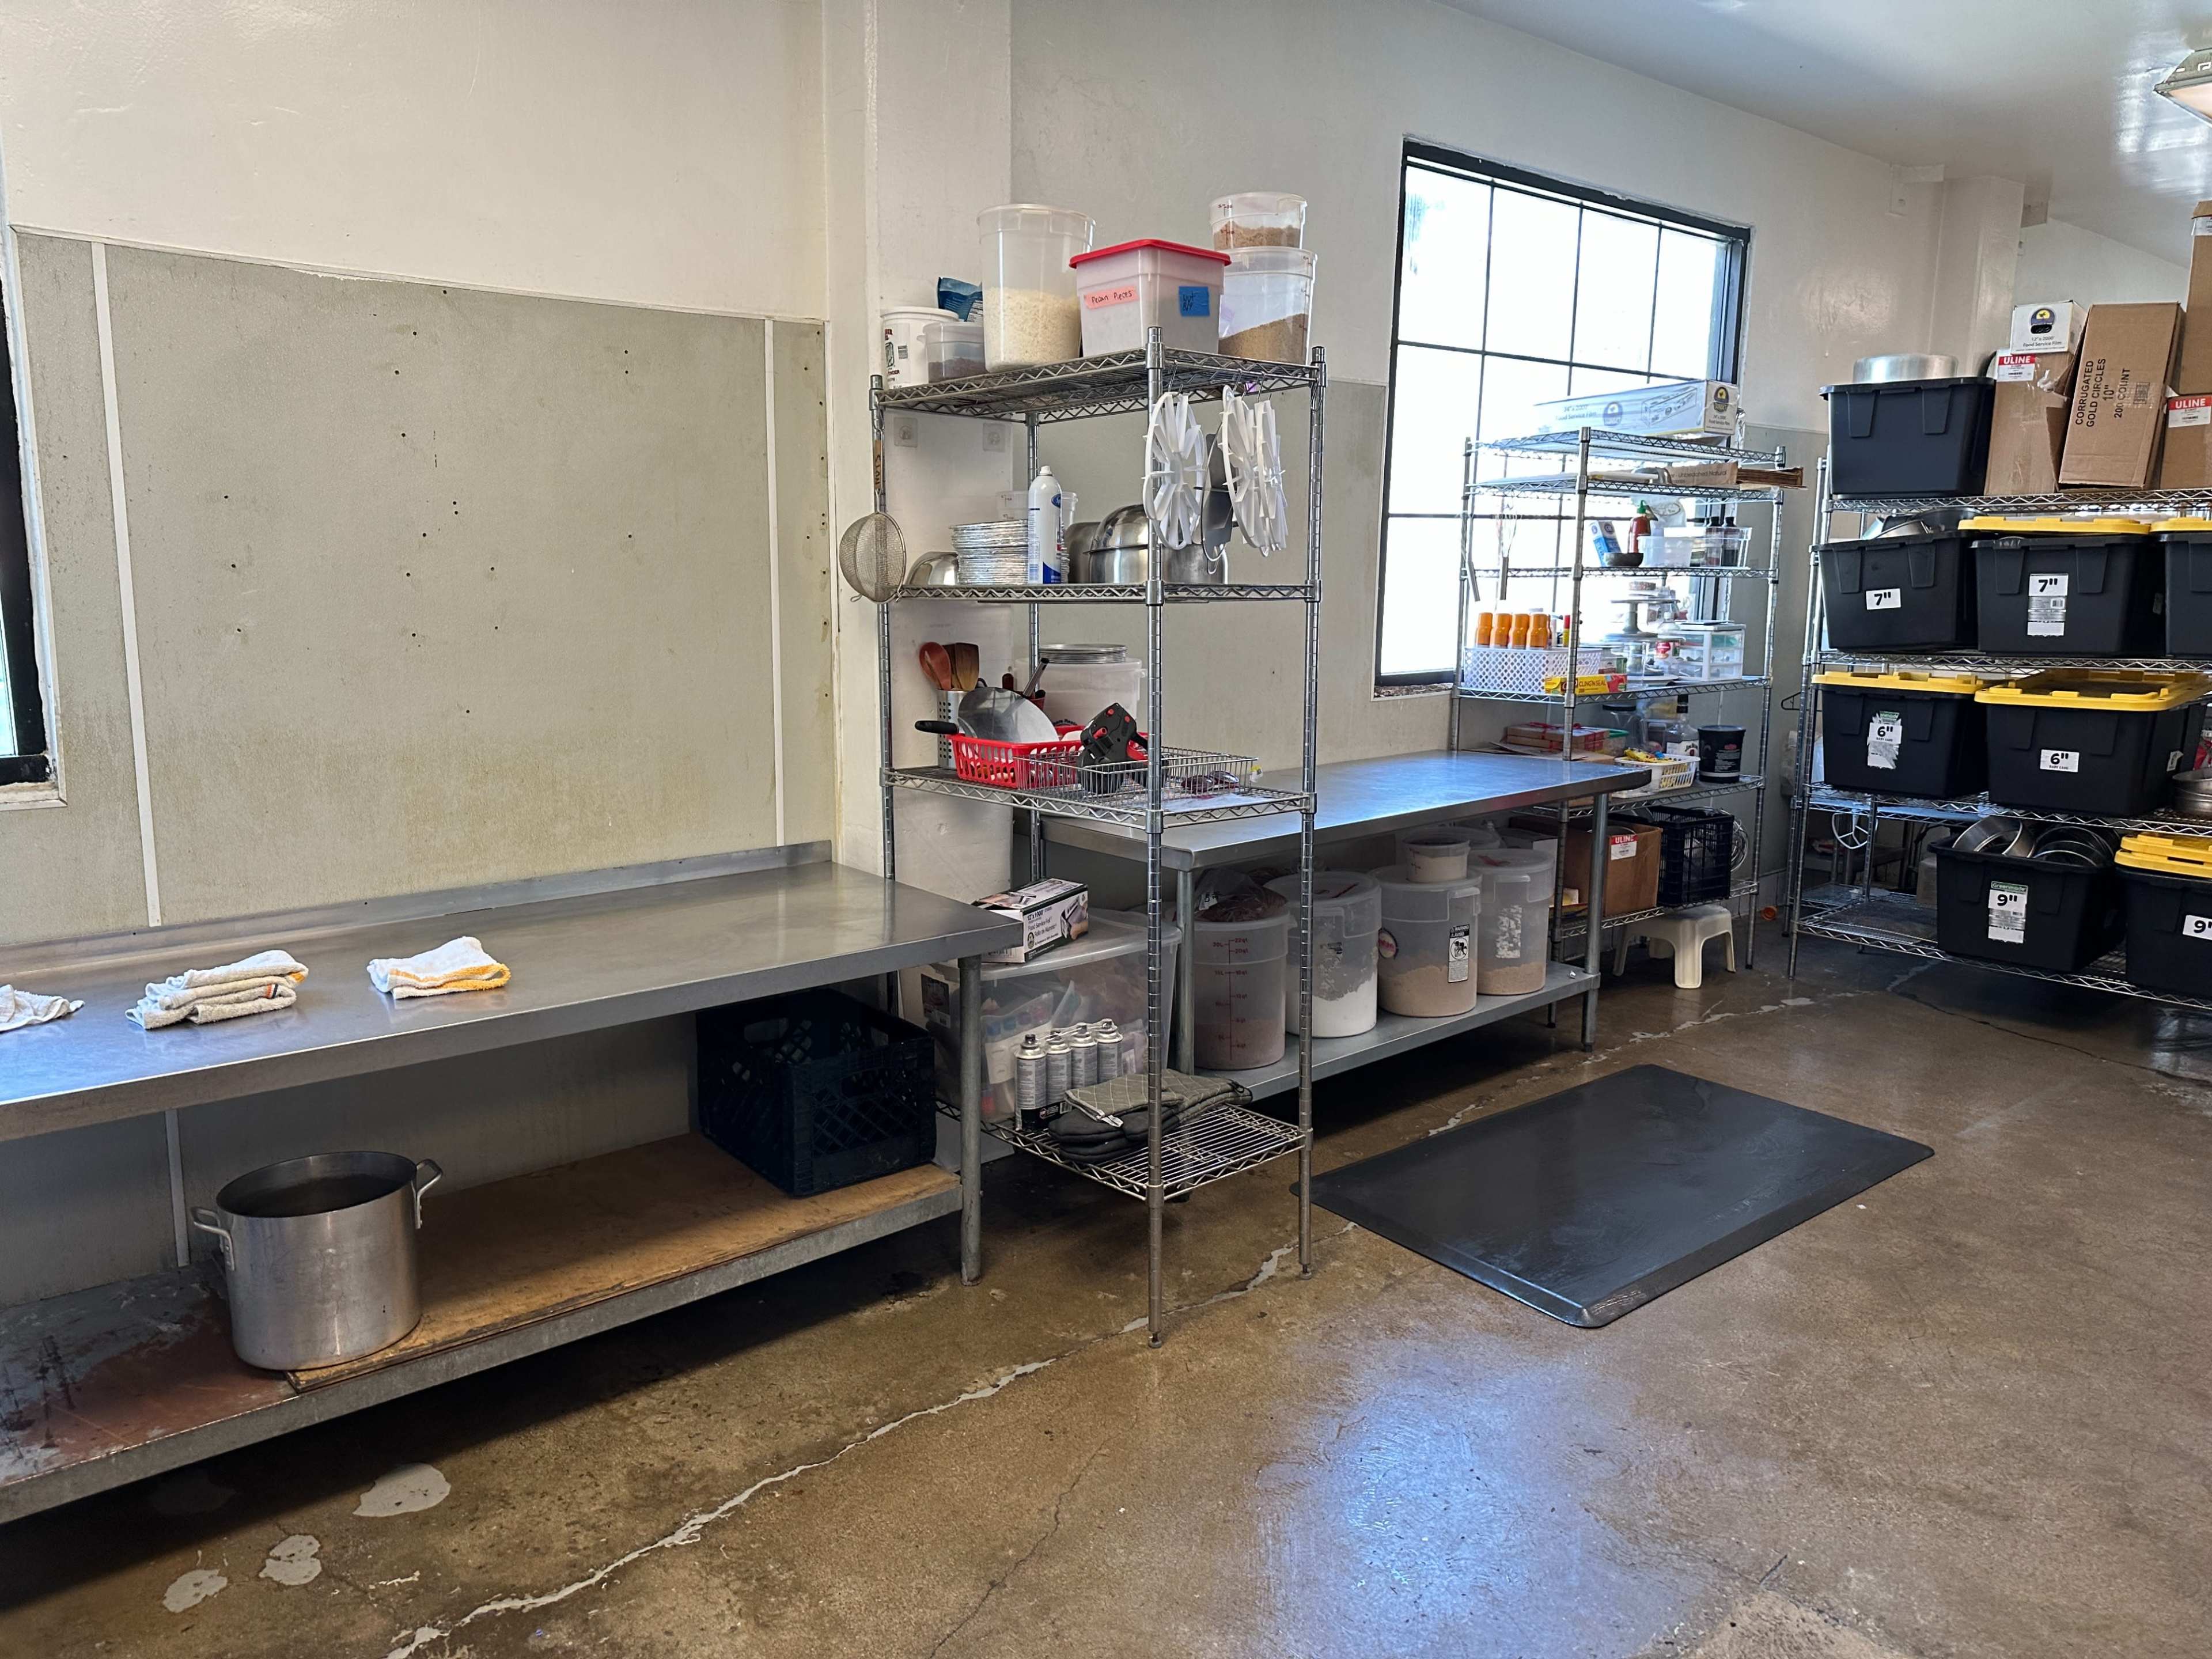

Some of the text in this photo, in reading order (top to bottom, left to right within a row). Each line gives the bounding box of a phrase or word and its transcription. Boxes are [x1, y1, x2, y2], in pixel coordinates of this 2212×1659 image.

[1092, 294, 1108, 304] Pecan
[2003, 356, 2031, 364] ULINE
[2075, 360, 2093, 425] CORRUGATED
[2086, 358, 2106, 427] GOLD CIRCLES
[2103, 384, 2115, 401] 10"
[2114, 368, 2131, 418] 200 COUNT
[2175, 397, 2206, 409] ULINE
[2039, 578, 2058, 592] 7"
[1874, 592, 1891, 606] 7"
[1877, 726, 1893, 737] 6"
[2050, 752, 2069, 765] 6"
[1997, 893, 2017, 906] 9"
